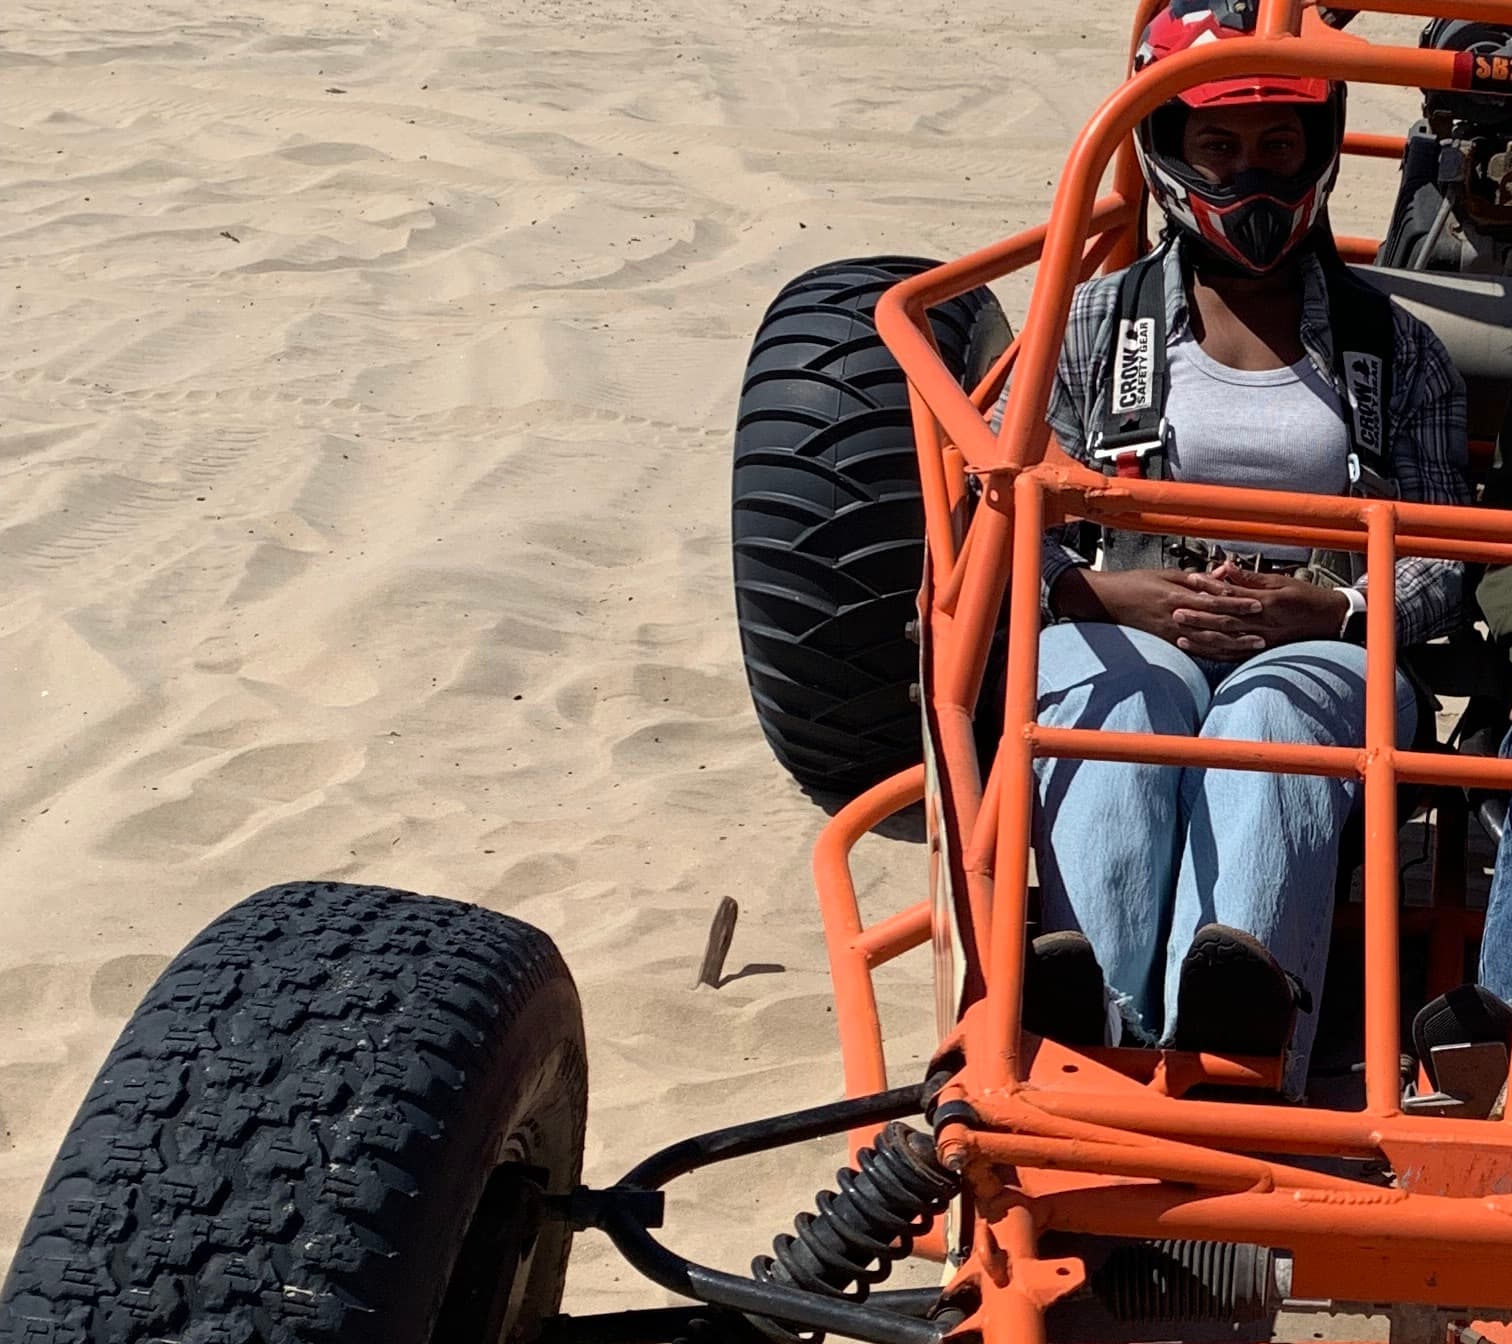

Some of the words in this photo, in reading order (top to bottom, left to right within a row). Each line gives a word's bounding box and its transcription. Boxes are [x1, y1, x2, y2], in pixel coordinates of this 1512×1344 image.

[1139, 322, 1149, 353] GEAR
[1120, 347, 1139, 408] CROW
[1137, 356, 1148, 404] SAFETY
[1353, 380, 1375, 446] CROW
